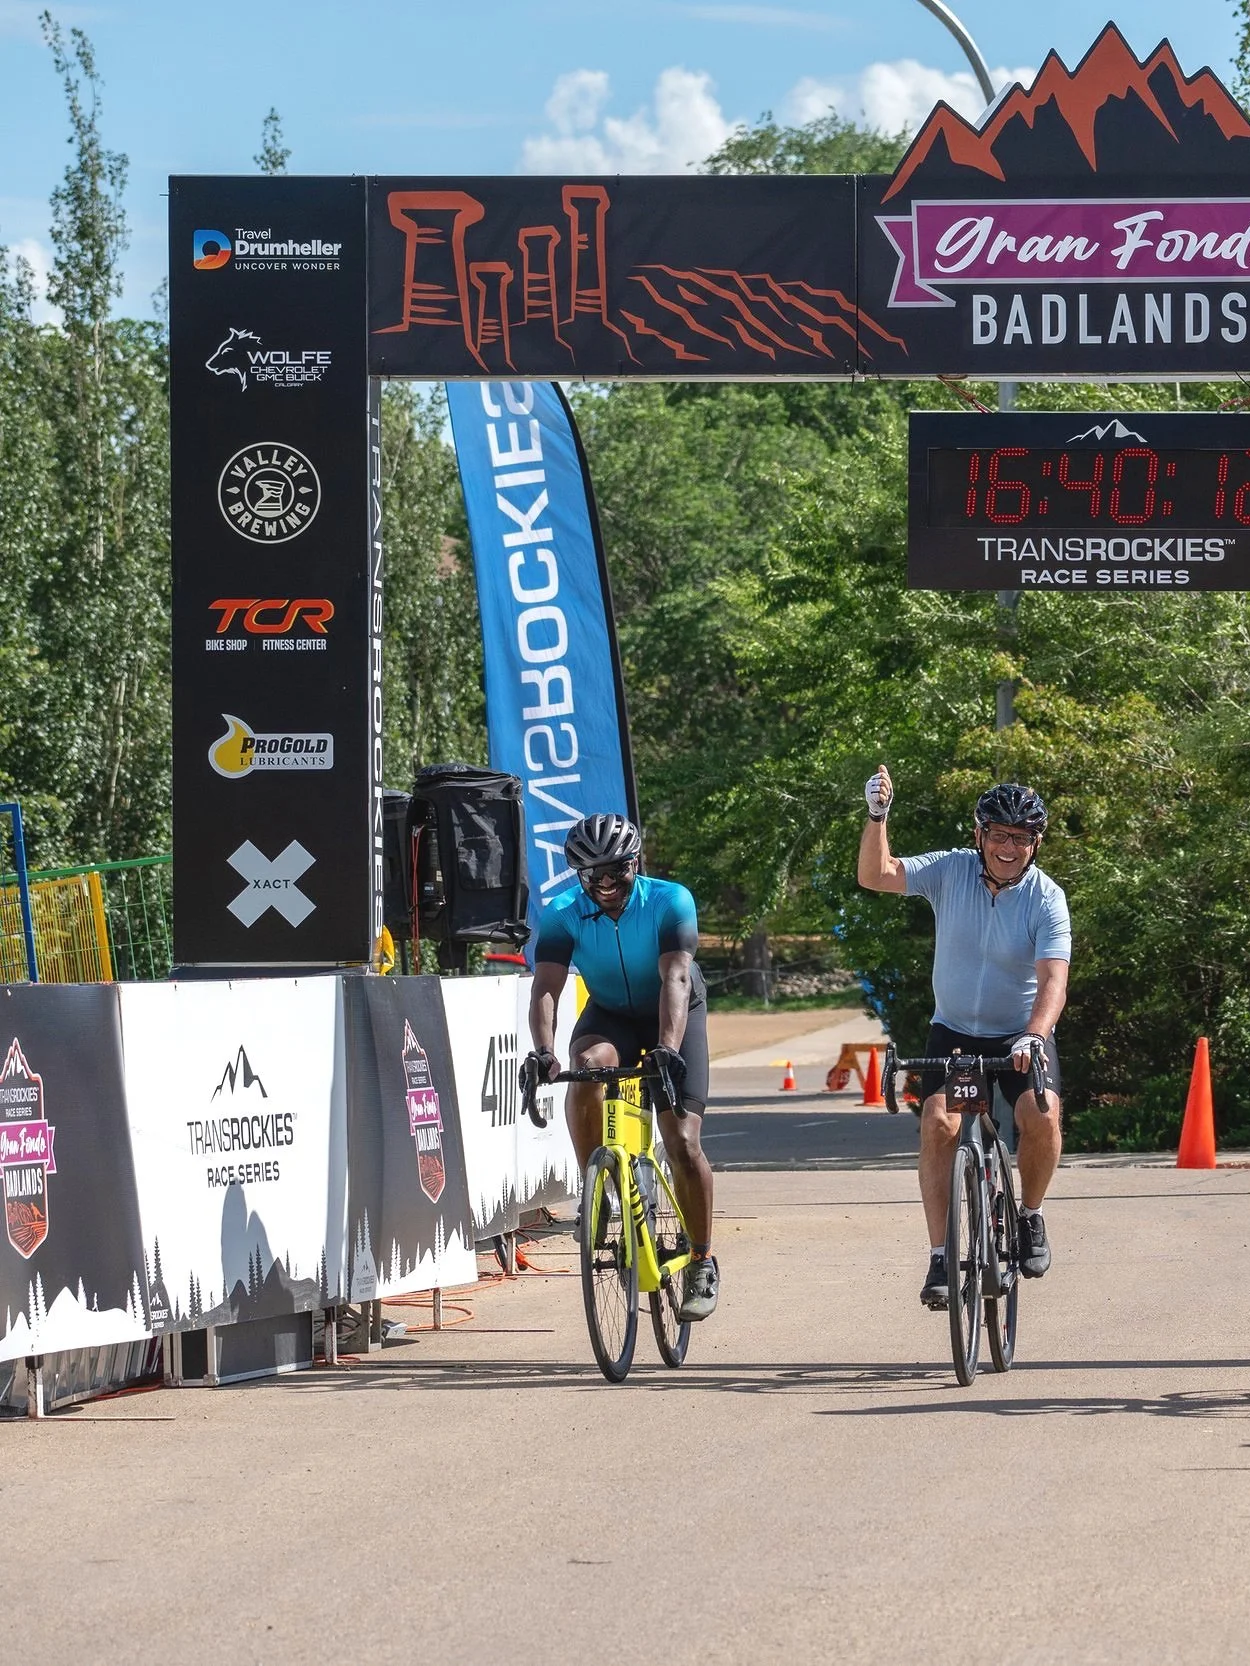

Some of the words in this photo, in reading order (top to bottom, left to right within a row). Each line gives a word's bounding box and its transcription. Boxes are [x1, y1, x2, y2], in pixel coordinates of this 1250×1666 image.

[235, 228, 271, 240] Travel
[235, 239, 342, 256] Drumheller
[235, 262, 287, 271] UNCOVER
[292, 262, 340, 271] WONDER
[972, 292, 1247, 345] BADLANDS
[247, 351, 331, 364] WOLFE
[230, 449, 308, 480] VALLEY
[227, 501, 311, 537] BREWING
[1021, 569, 1088, 584] RACE
[1096, 569, 1190, 585] SERIES
[208, 598, 334, 634] TCR
[206, 639, 224, 650] BIKE
[227, 639, 247, 650] SHOP
[263, 639, 293, 650] FITNESS
[296, 639, 327, 650] CENTER
[372, 403, 383, 938] TRANSROCKIES
[240, 756, 325, 766] LUBRICANTS
[252, 879, 291, 889] XACT
[953, 1085, 978, 1098] 219
[607, 1103, 616, 1139] BMC
[207, 1165, 236, 1188] RACE
[238, 1160, 280, 1185] SERIES
[5, 1168, 43, 1198] BADLANDS
